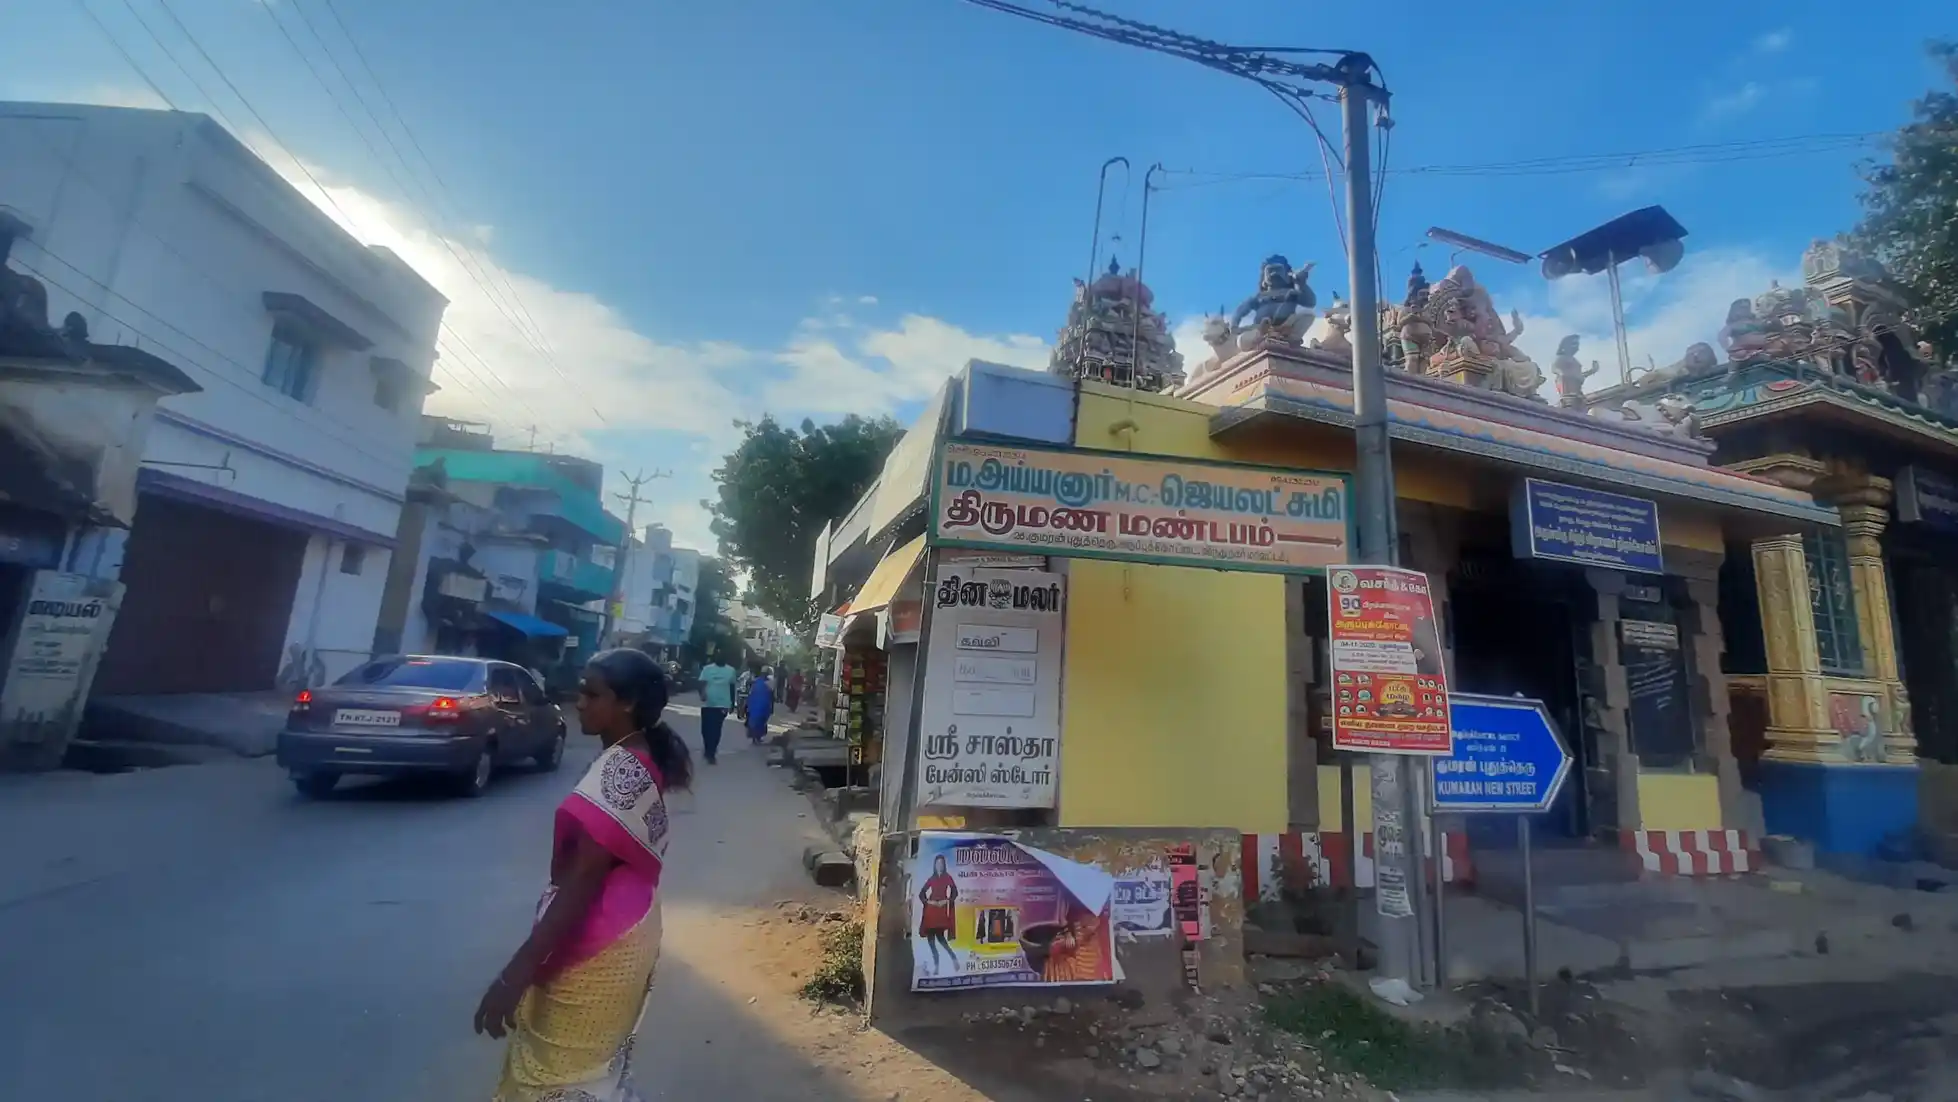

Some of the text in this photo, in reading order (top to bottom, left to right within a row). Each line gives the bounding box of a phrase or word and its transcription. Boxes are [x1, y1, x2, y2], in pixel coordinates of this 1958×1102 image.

[943, 489, 1277, 547] திருமண மண்டபம்
[937, 575, 1060, 612] தின மலர்
[965, 726, 1055, 762] சாஸ்தா
[925, 762, 1051, 785] பேன்ஸி ஸ்டோர்
[1437, 781, 1537, 795] KUMARAN NEW STREET
